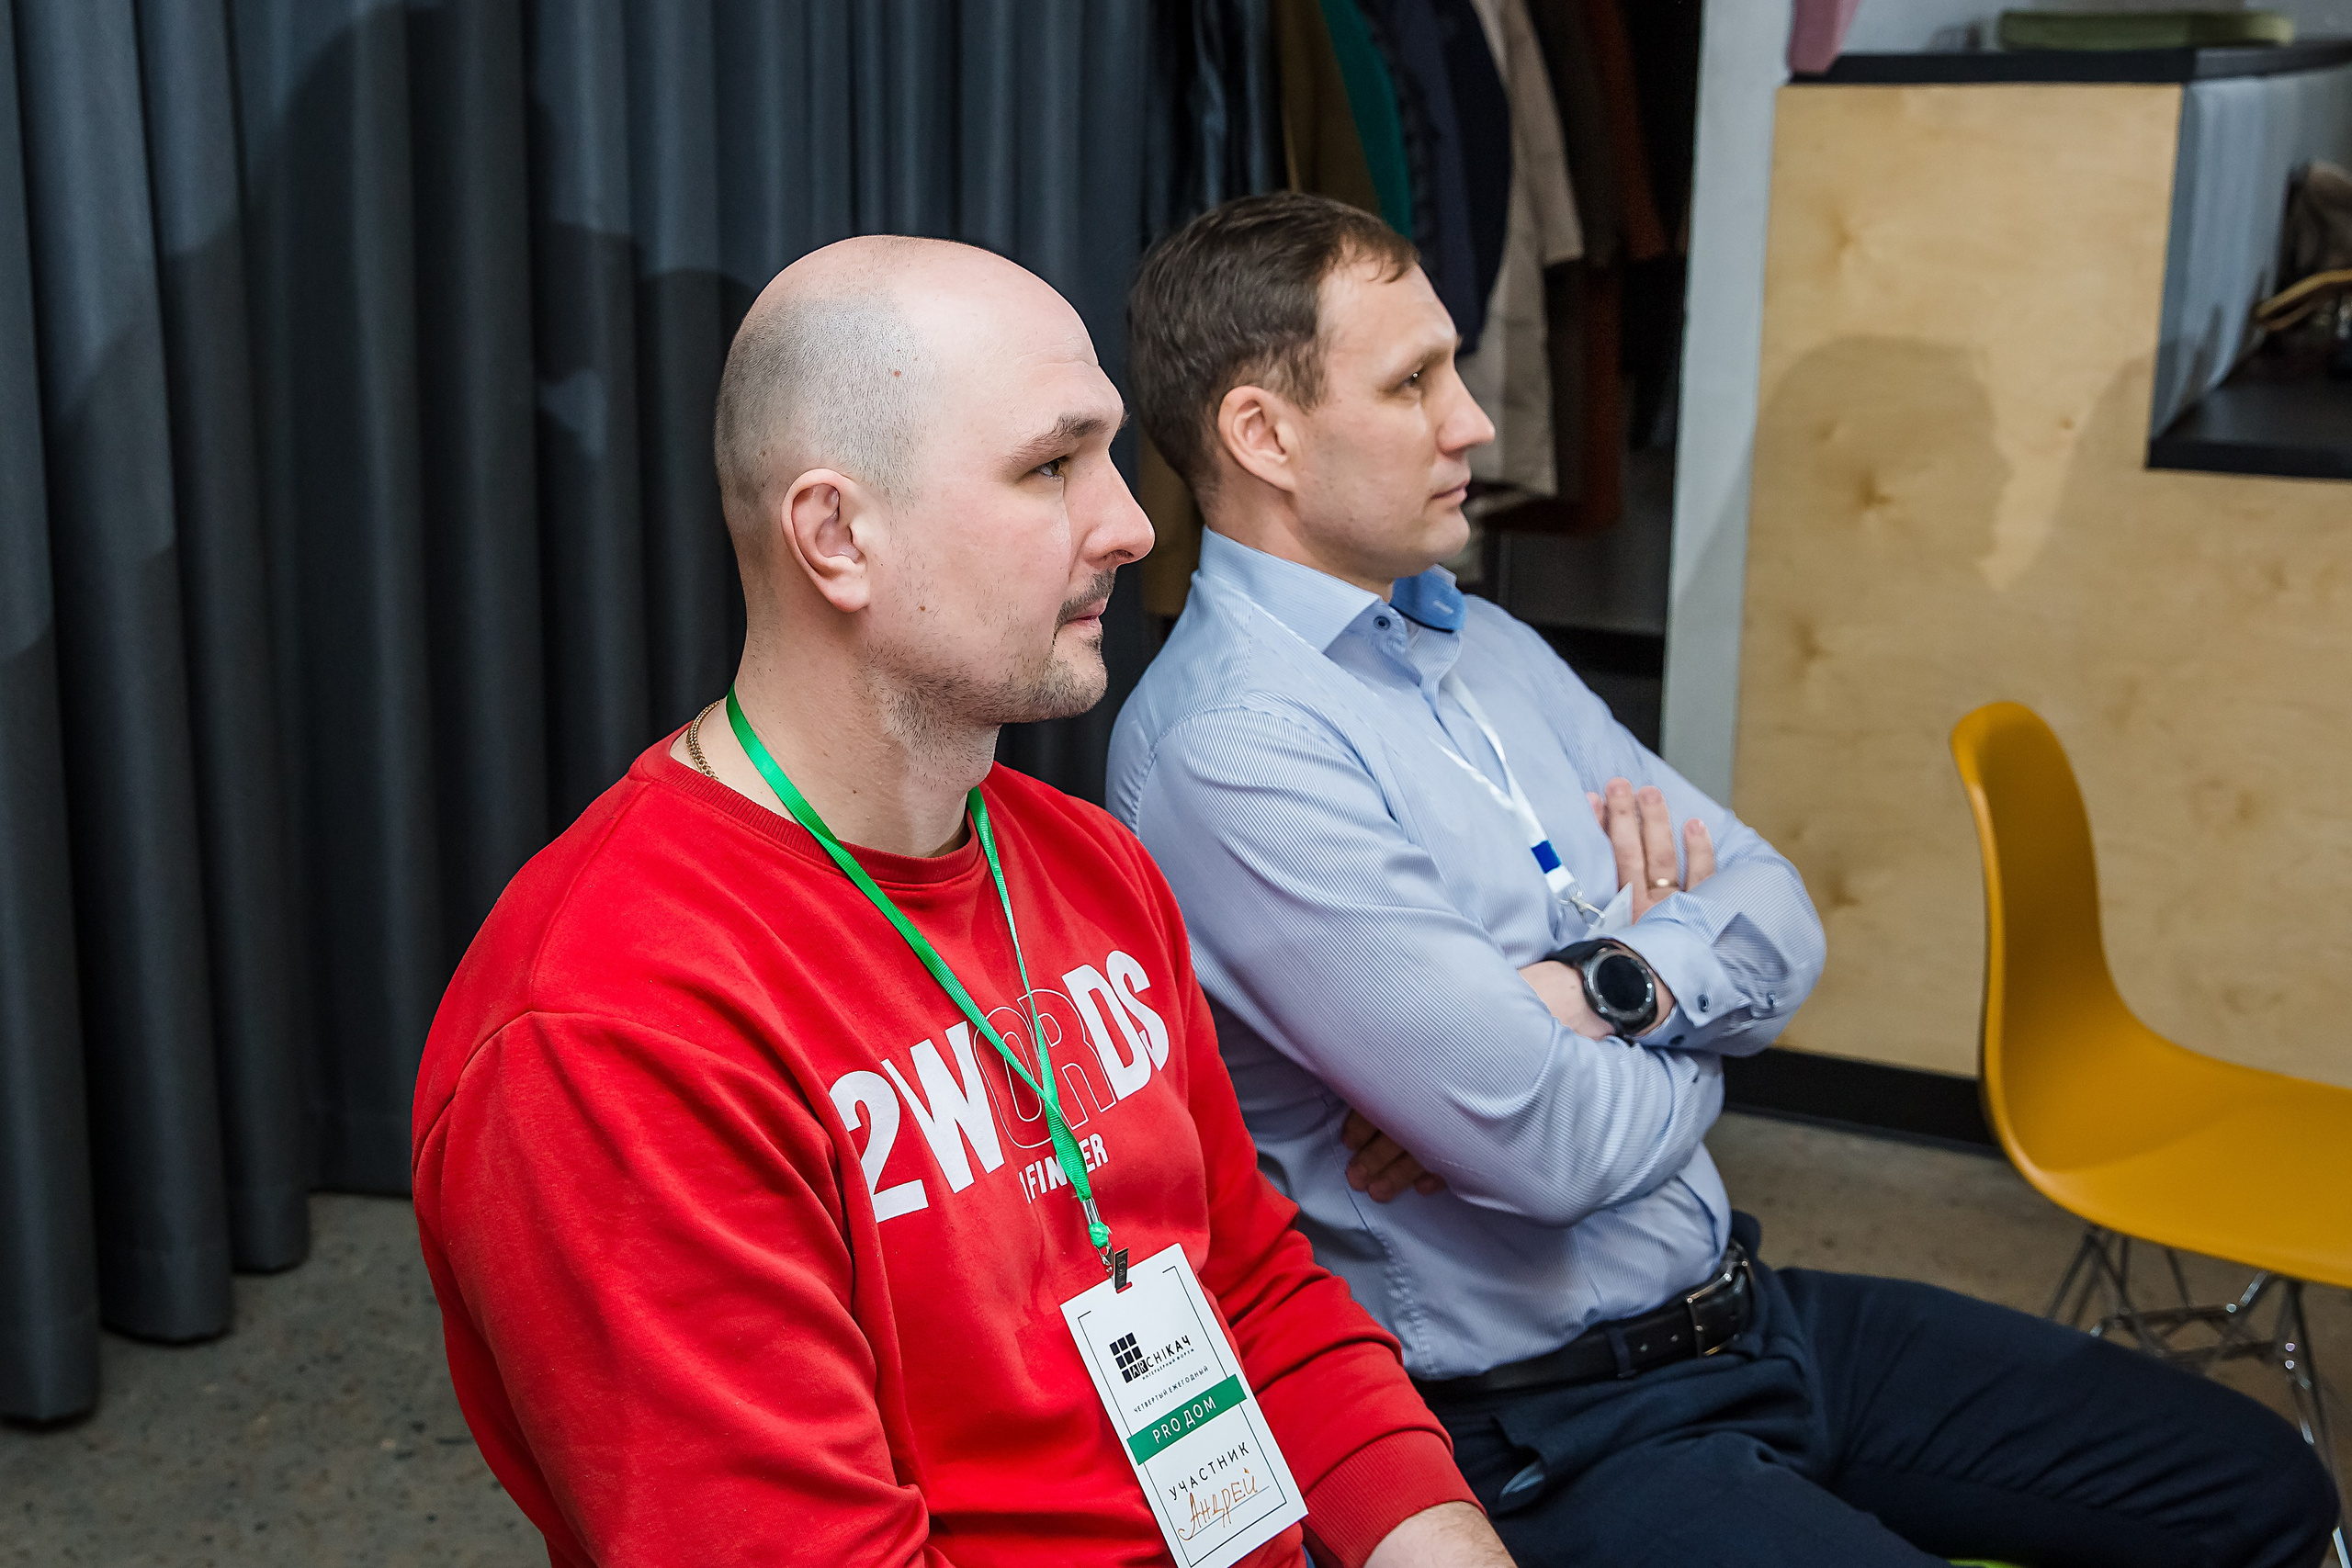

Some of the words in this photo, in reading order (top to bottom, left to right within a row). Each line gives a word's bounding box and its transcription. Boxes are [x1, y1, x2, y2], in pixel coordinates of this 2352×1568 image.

[1018, 1133, 1109, 1204] 1FINER
[1133, 1389, 1168, 1413] ЧЕТВЕРТЫЙ
[1168, 1365, 1209, 1393] ЕЖЕГОДНЫЙ
[1183, 1396, 1216, 1428] ДОМ
[1169, 1442, 1250, 1501] УЧАСТНИК
